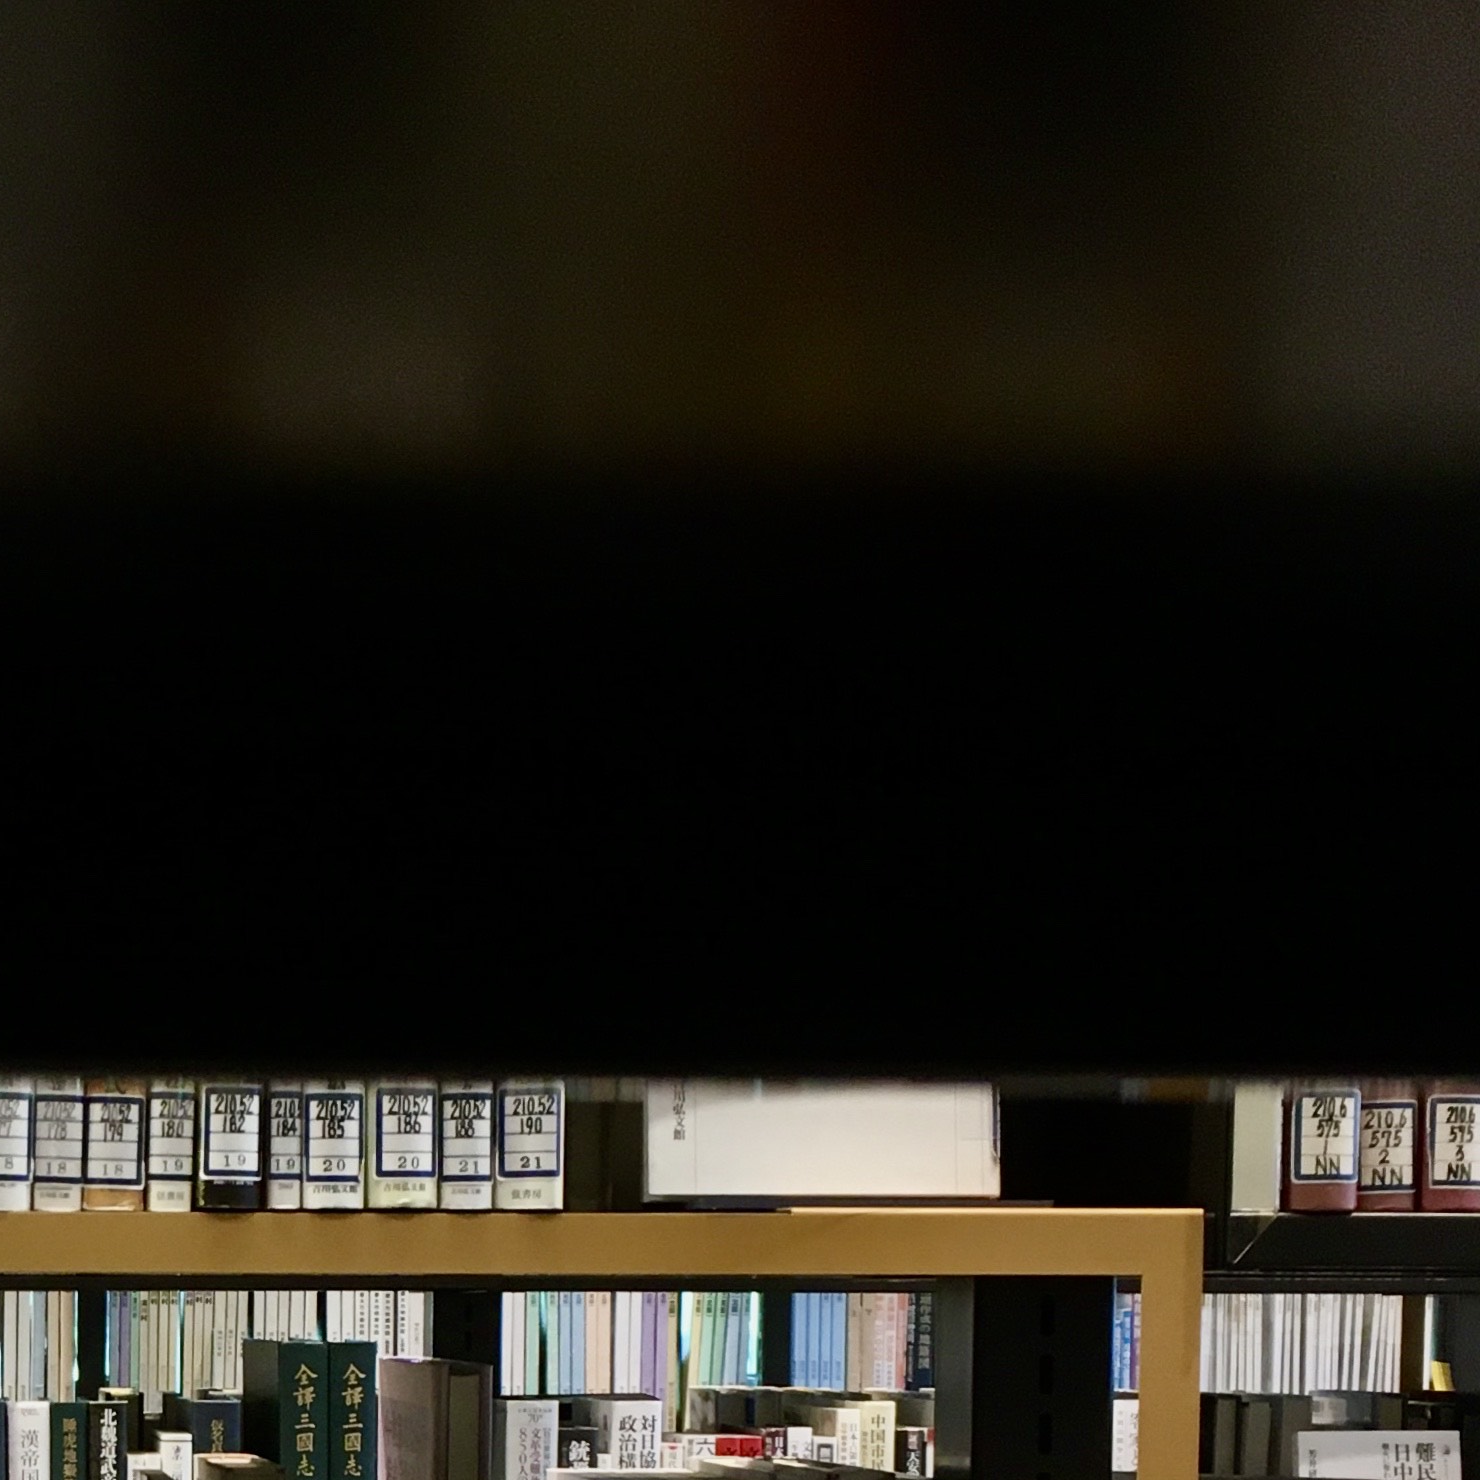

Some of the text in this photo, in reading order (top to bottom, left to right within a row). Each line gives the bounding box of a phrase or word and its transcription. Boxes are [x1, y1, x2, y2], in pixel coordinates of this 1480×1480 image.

[222, 1115, 246, 1134] 182
[321, 1119, 345, 1140] 185
[396, 1114, 422, 1134] 186
[519, 1116, 544, 1136] 190
[1315, 1120, 1341, 1139] 575
[1369, 1128, 1403, 1149] 575
[322, 1159, 347, 1173] 20
[397, 1156, 421, 1170] 20
[520, 1155, 542, 1170] 21
[1314, 1155, 1341, 1175] NN
[1377, 1148, 1391, 1165] 2
[1371, 1166, 1404, 1186] NN
[293, 1363, 318, 1478] 全譯三國志
[341, 1363, 366, 1478] 全譯三國志
